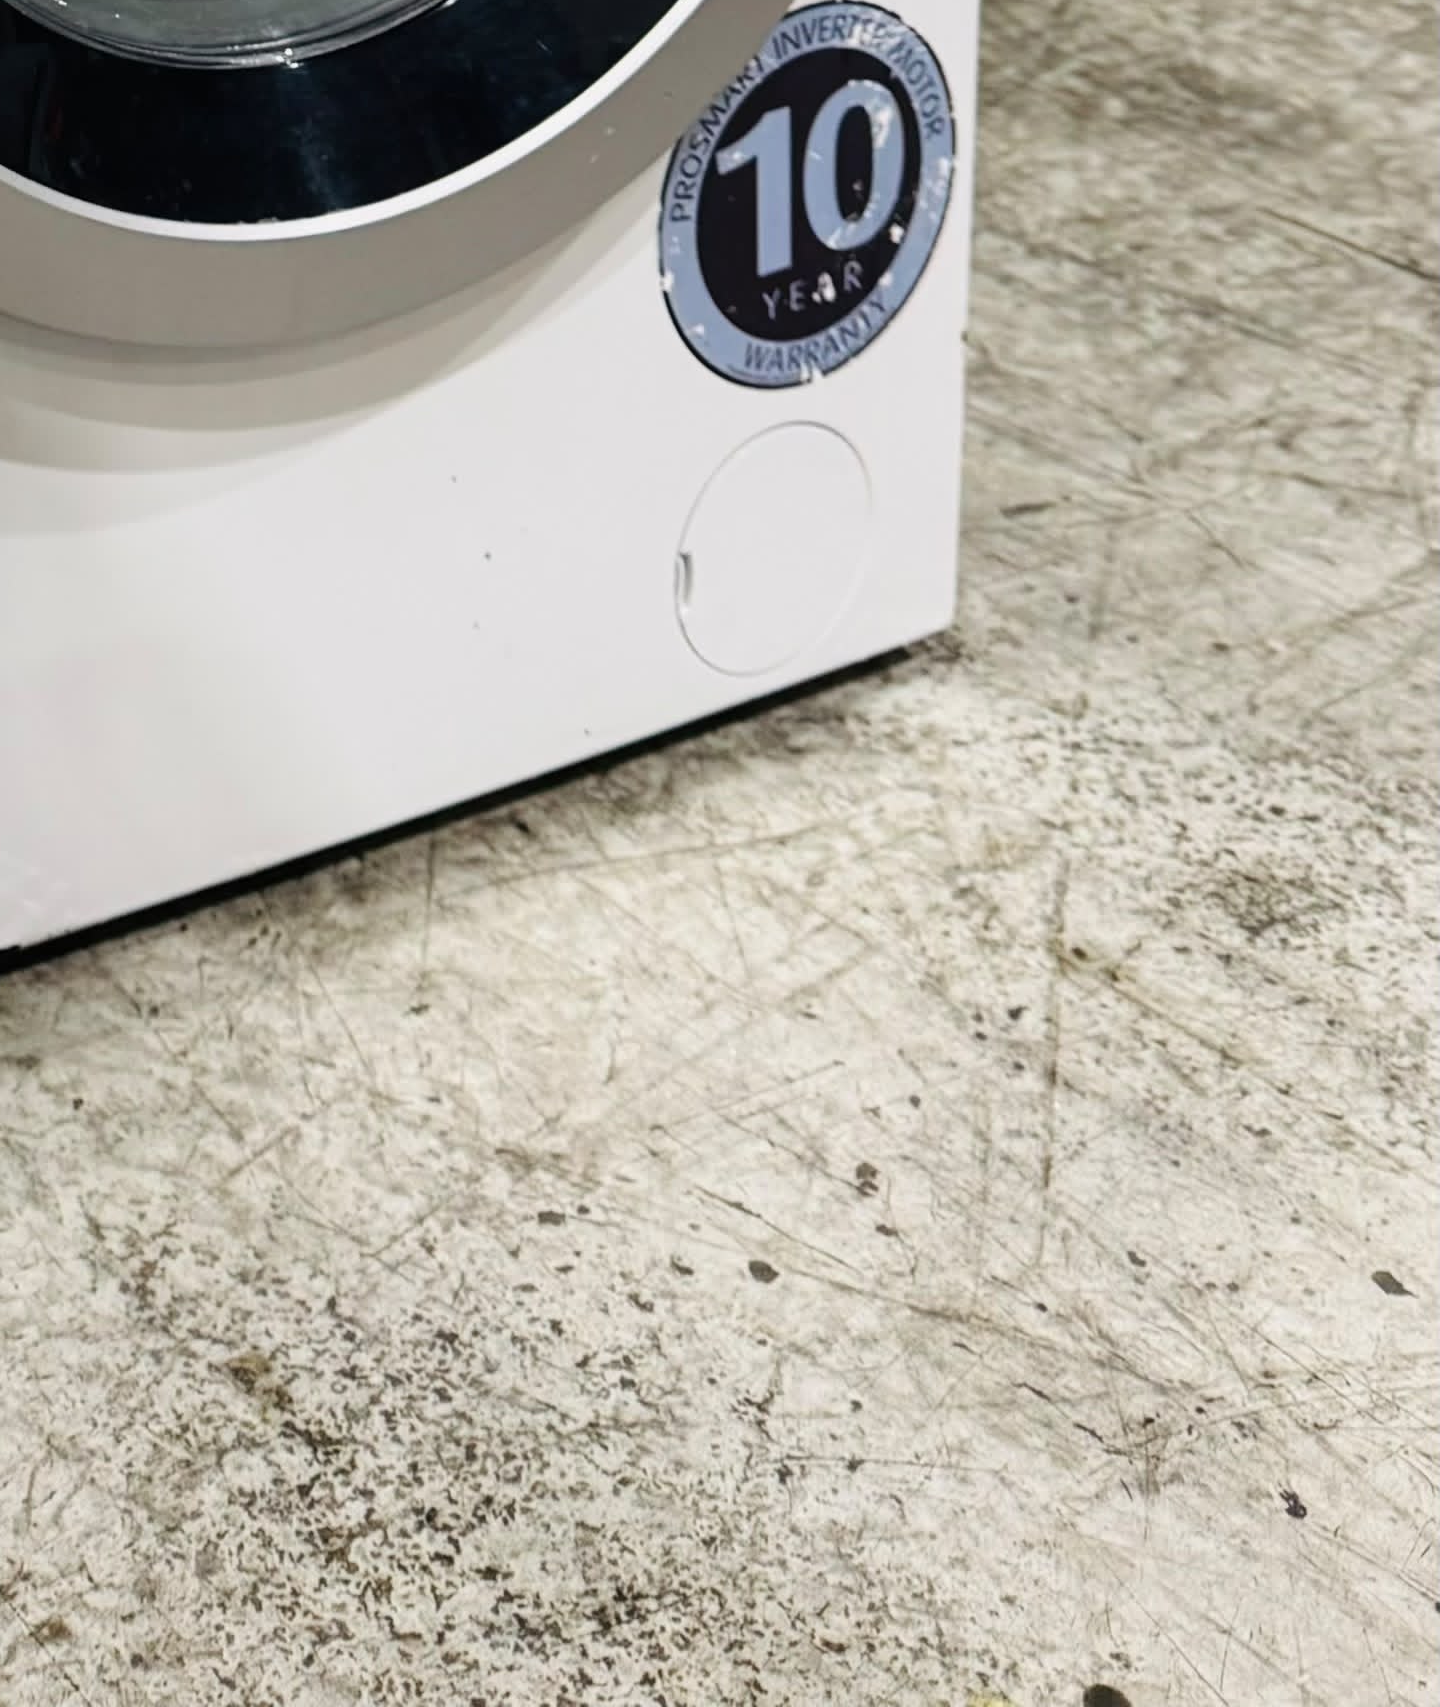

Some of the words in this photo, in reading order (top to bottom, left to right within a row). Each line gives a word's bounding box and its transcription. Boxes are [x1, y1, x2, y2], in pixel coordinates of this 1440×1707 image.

[714, 79, 905, 279] 10
[743, 290, 888, 374] WARRANTY
[762, 260, 864, 322] YEAR
